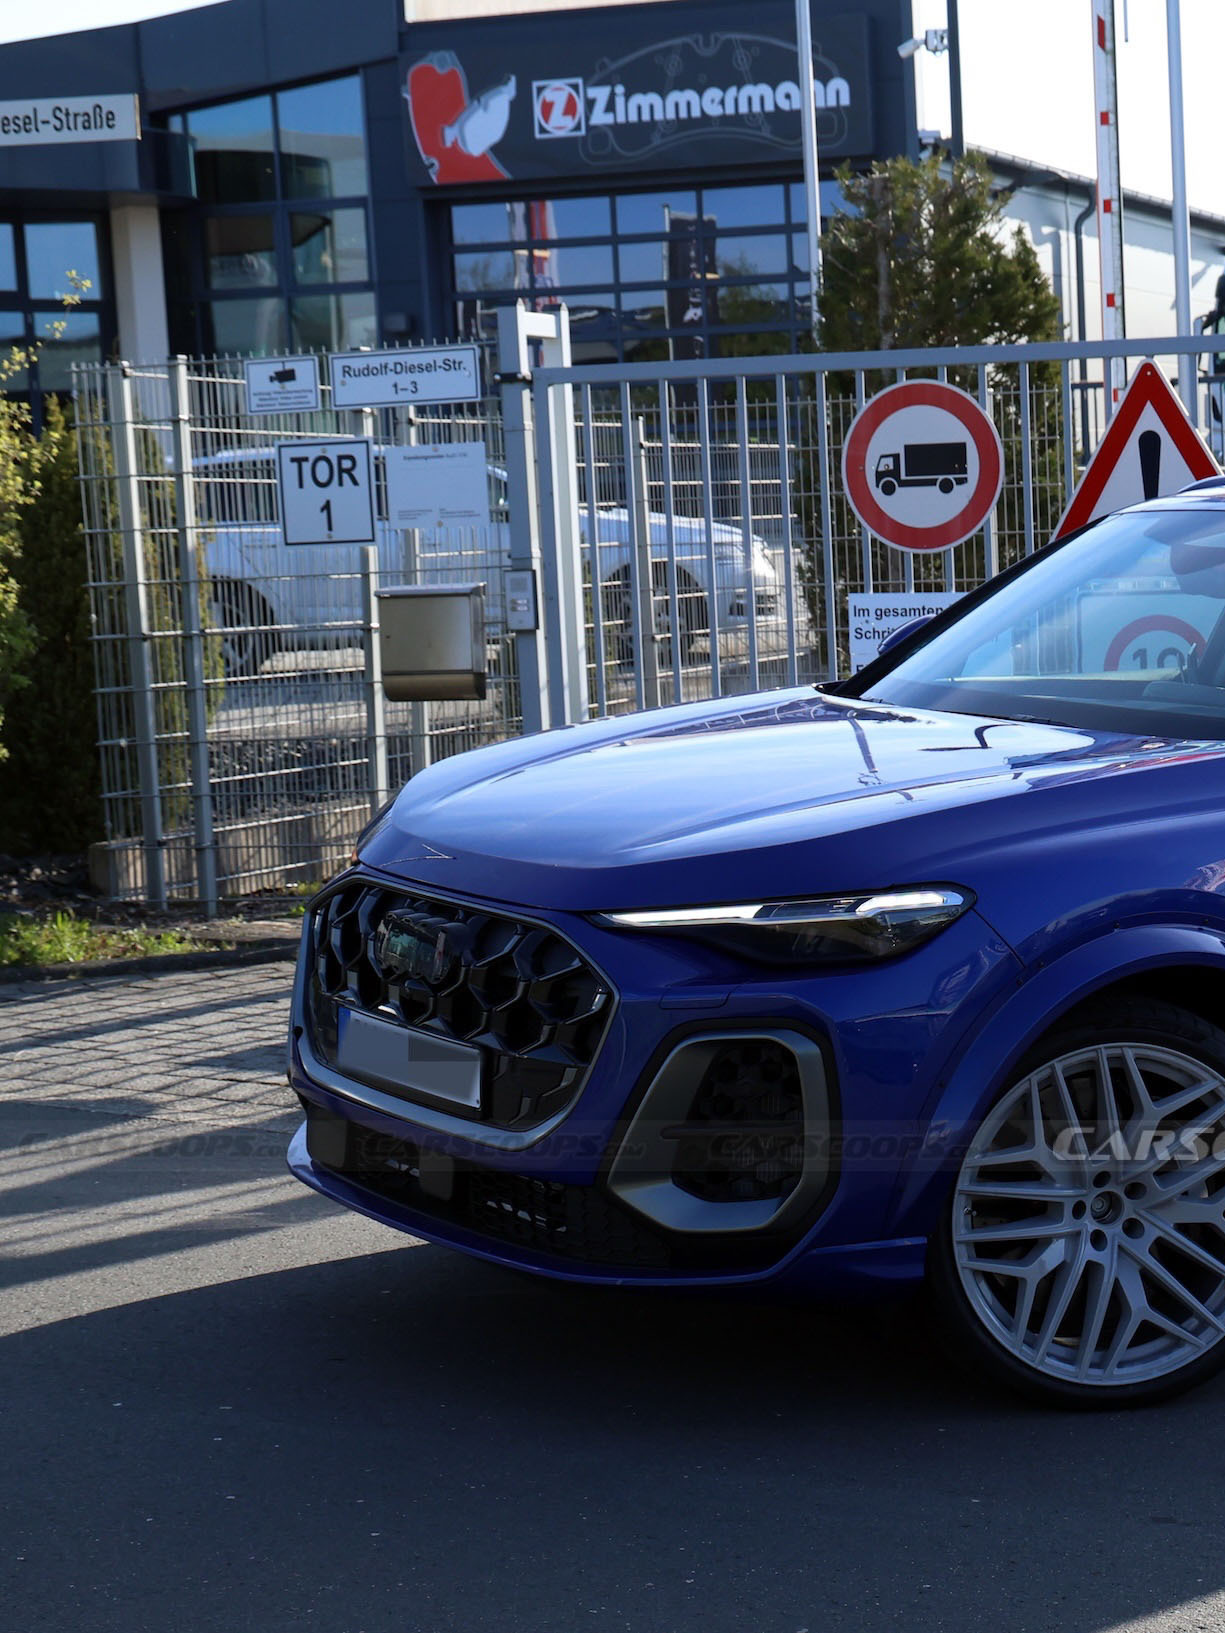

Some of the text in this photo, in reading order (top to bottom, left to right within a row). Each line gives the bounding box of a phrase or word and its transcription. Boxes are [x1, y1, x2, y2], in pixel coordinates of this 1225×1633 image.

[342, 358, 466, 378] Rudolf-Diesel-Str.
[290, 454, 360, 489] TOR
[319, 499, 333, 532] 1
[853, 605, 944, 621] Im gesamten
